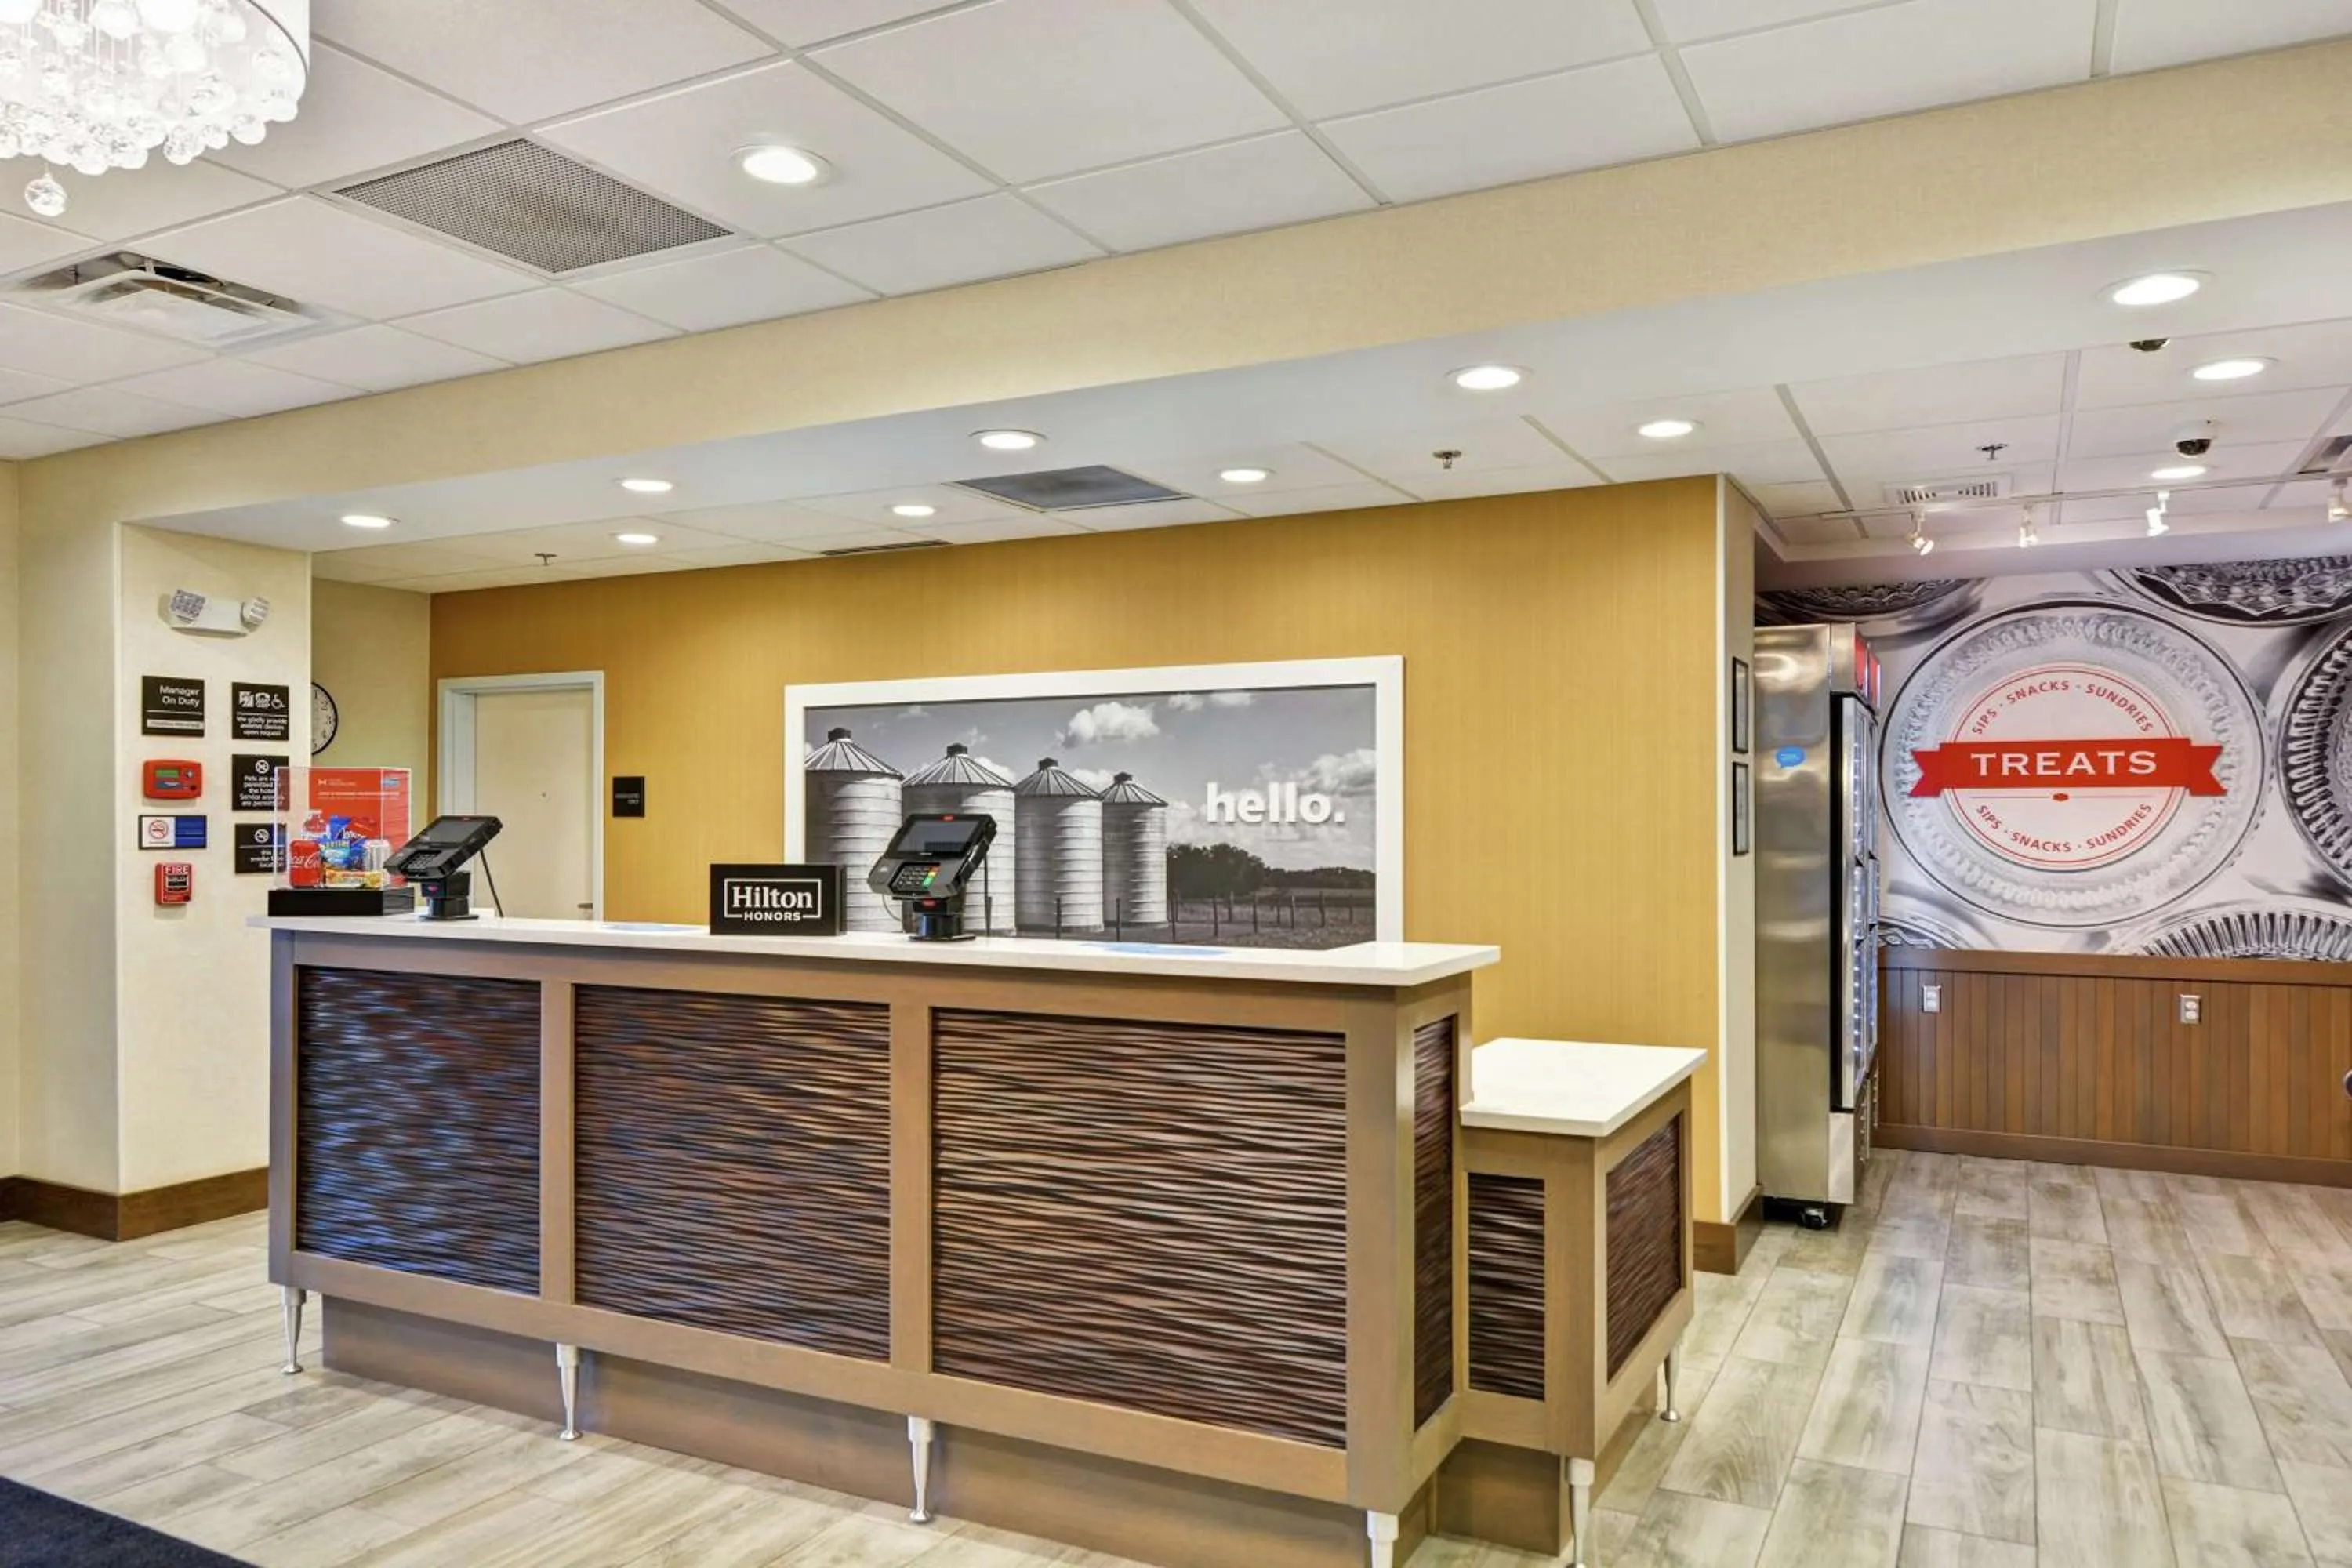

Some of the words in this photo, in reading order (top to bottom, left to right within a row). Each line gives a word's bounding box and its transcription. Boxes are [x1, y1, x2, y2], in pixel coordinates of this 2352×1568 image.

[159, 685, 201, 696] Manager
[162, 695, 176, 705] On
[178, 697, 201, 708] Duty
[1972, 707, 1998, 735] SIPS
[2006, 680, 2070, 705] SNACKS
[2085, 683, 2154, 732] SUNDRIES
[1970, 750, 2157, 776] TREATS
[1207, 782, 1345, 823] hello.
[1975, 804, 2001, 829] SIPS
[2009, 831, 2071, 853] SNACKS
[2086, 803, 2152, 850] SUNDRIES
[165, 865, 189, 873] FIRE
[732, 887, 813, 909] Hilton
[743, 912, 801, 921] HONORS
